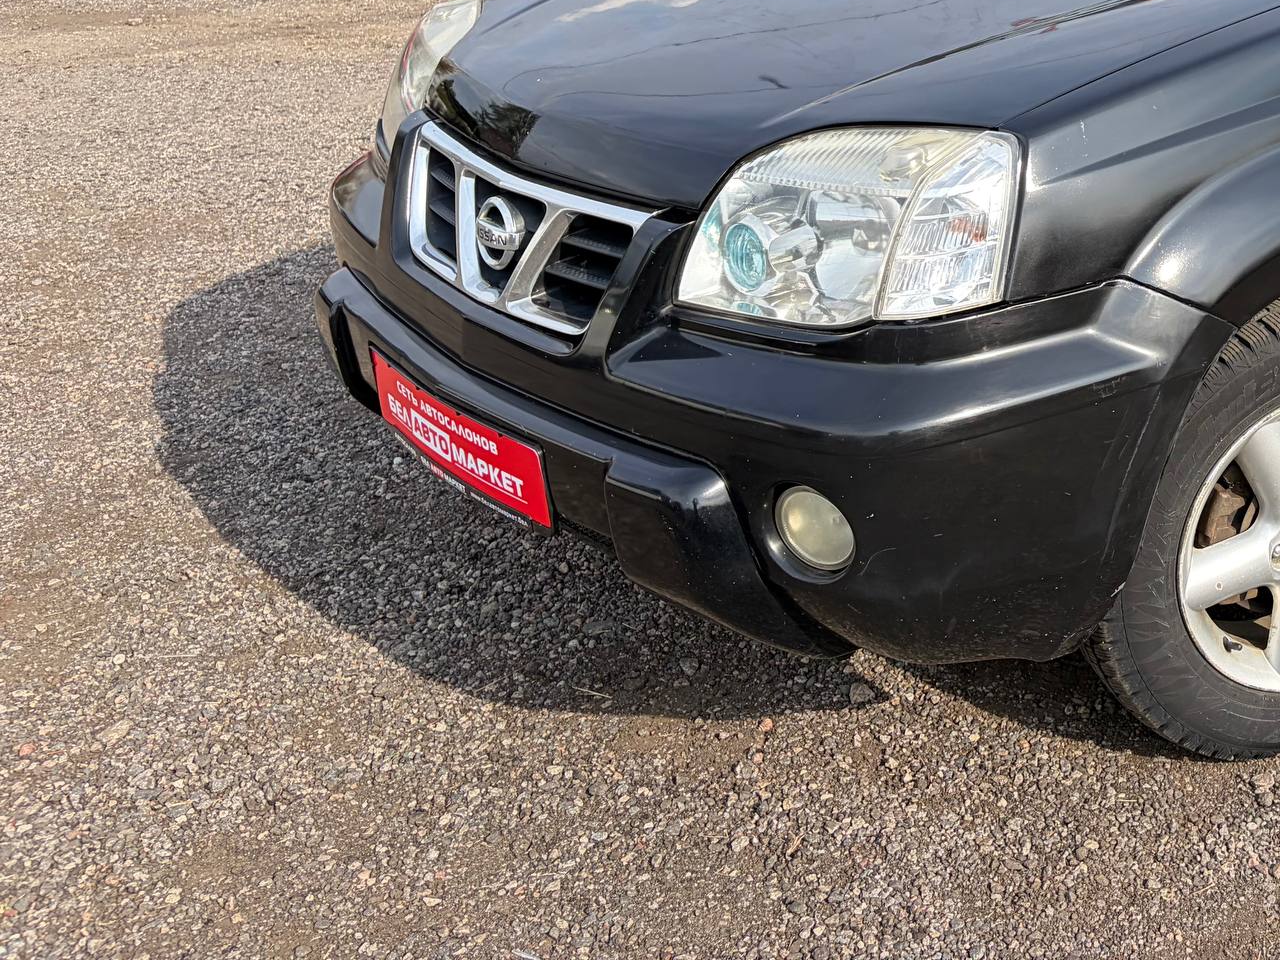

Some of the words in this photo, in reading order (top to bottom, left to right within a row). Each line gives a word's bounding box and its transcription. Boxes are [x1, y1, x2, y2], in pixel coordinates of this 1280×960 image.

[387, 393, 412, 428] БЕЛ
[414, 415, 450, 457] АВТО
[451, 442, 524, 498] МАРКЕТ
[396, 380, 418, 406] СЕТЬ
[420, 399, 499, 456] АВТОСАЛОНОВ
